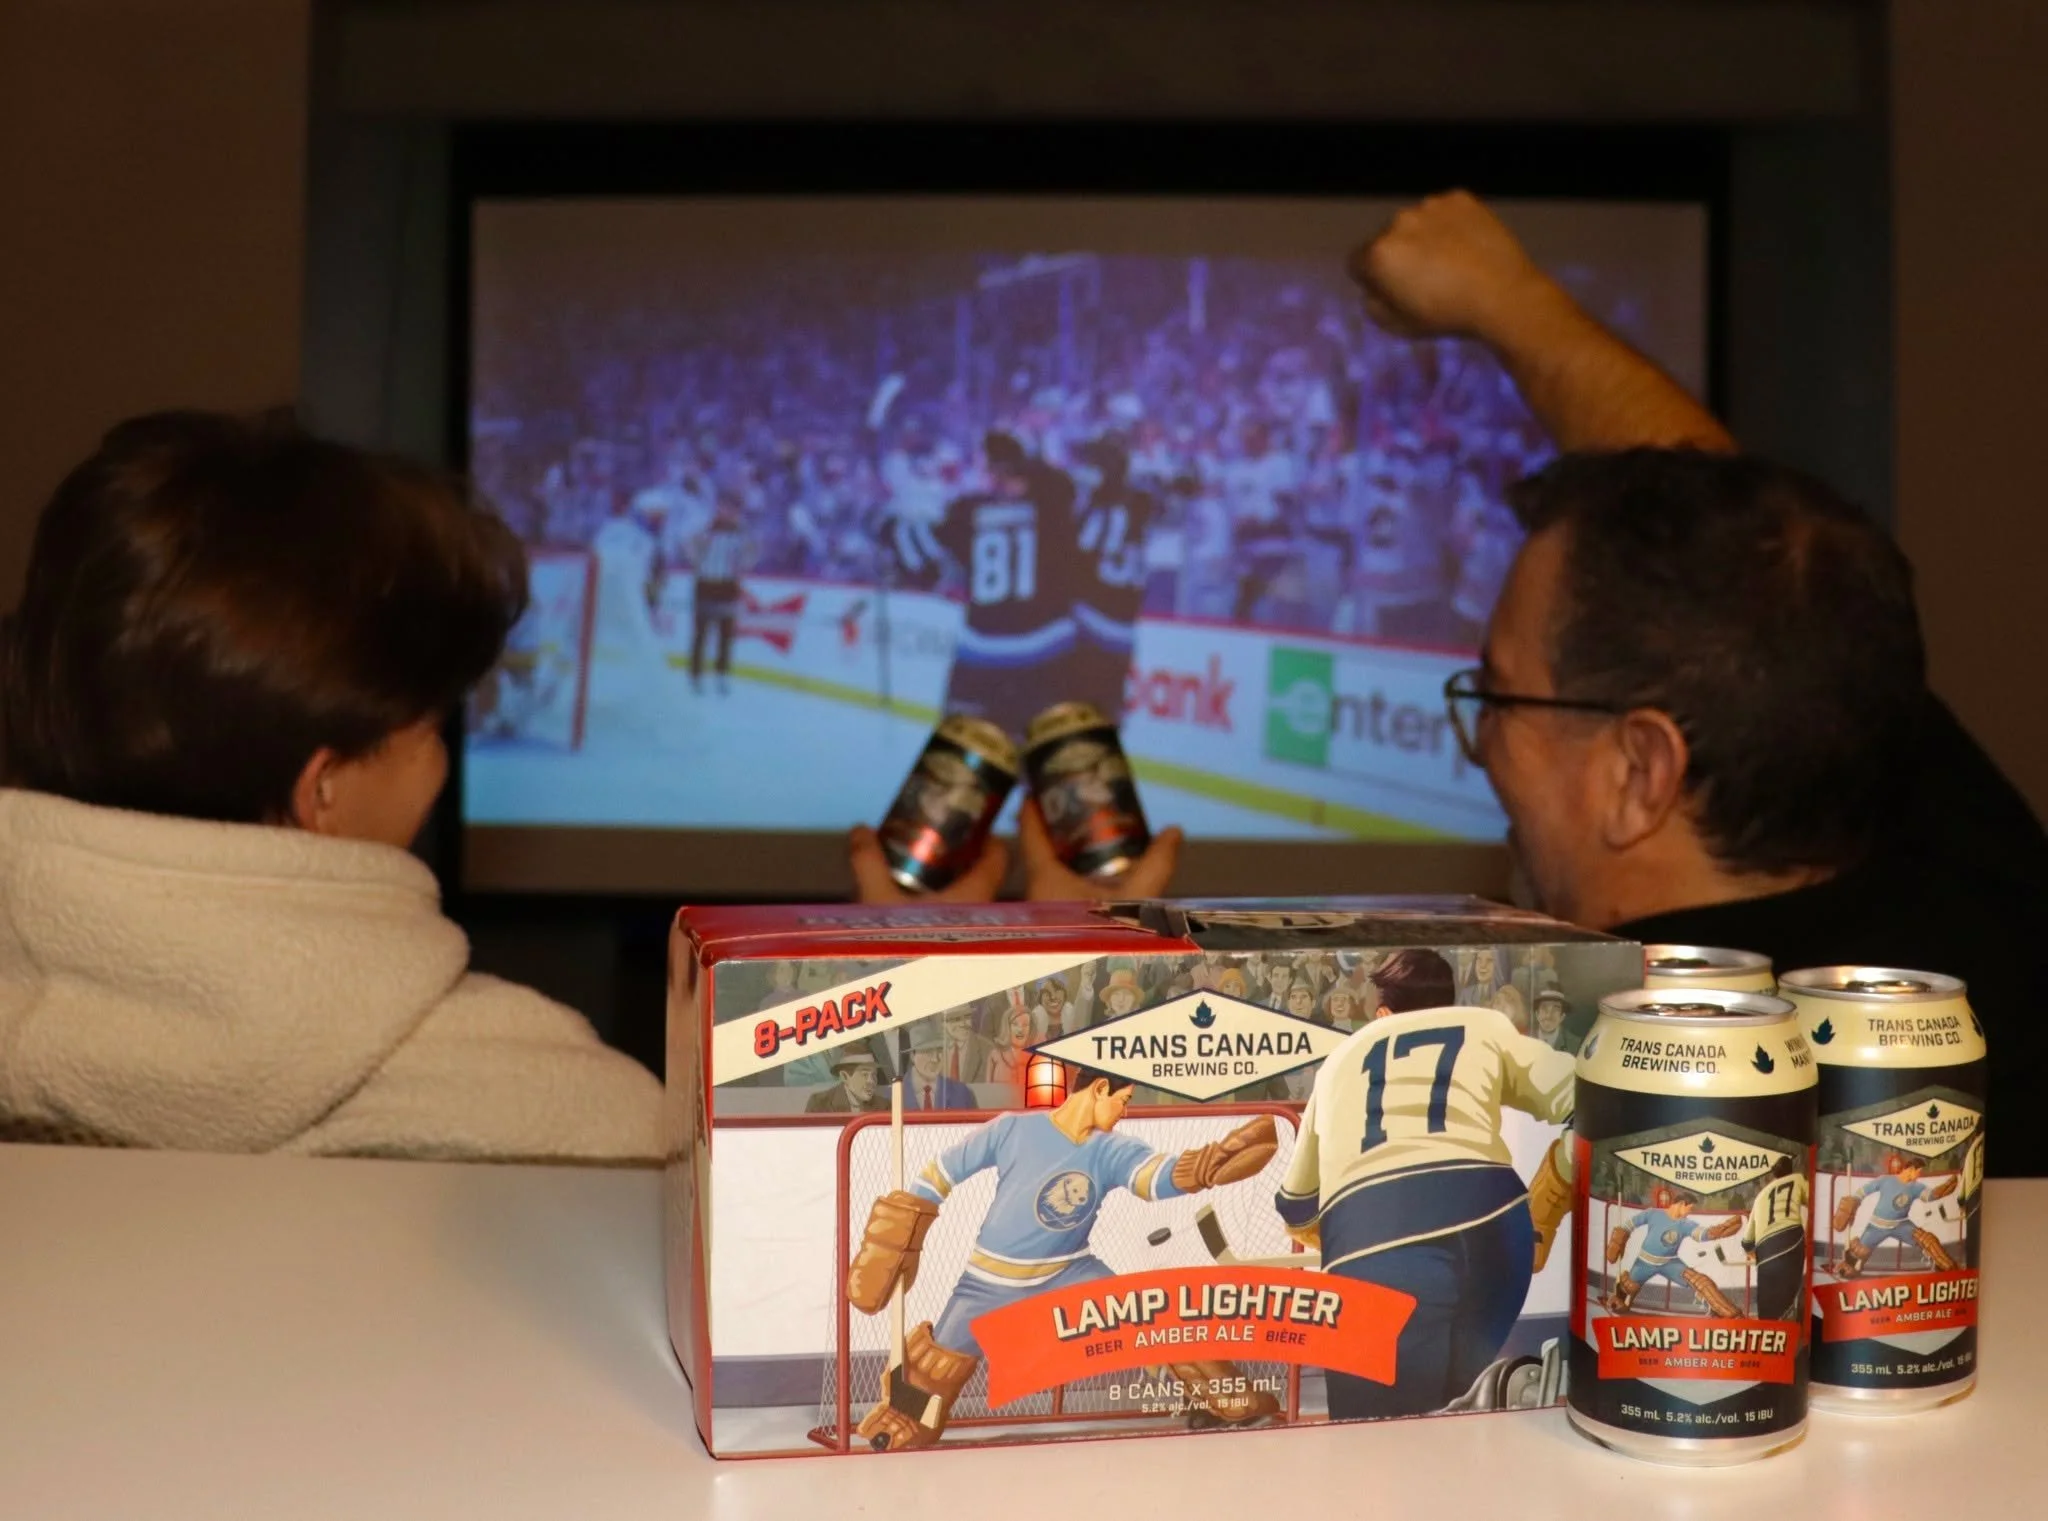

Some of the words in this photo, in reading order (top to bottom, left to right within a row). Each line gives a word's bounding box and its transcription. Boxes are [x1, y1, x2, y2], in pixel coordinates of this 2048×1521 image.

[972, 528, 1037, 605] 81
[754, 981, 892, 1057] 8-PACK
[1868, 1019, 1914, 1033] TRANS
[1917, 1015, 1962, 1031] CANADA
[1091, 1034, 1187, 1060] TRANS
[1197, 1031, 1313, 1057] CANADA
[1620, 1037, 1662, 1056] TRANS
[1665, 1043, 1727, 1059] CANADA
[1879, 1032, 1945, 1048] BREWING
[1947, 1031, 1963, 1045] CO.
[1152, 1062, 1228, 1077] BREWING
[1233, 1060, 1259, 1076] CO.
[1622, 1055, 1690, 1074] BREWING
[1695, 1061, 1720, 1074] CO.
[1360, 1025, 1466, 1154] 17
[1872, 1121, 1925, 1137] TRANS
[1929, 1116, 1975, 1135] CANADA
[1906, 1136, 1945, 1147] BREWING
[1641, 1151, 1697, 1169] TRANS
[1702, 1153, 1769, 1171] CANADA
[1675, 1171, 1721, 1182] BREWING
[1724, 1172, 1741, 1182] CO.
[1767, 1181, 1795, 1226] 17
[1838, 1285, 1912, 1314] LAMP
[1052, 1287, 1169, 1341] LAMP
[1177, 1282, 1343, 1329] LIGHTER
[1895, 1310, 1933, 1323] AMBER
[1935, 1308, 1952, 1320] ALE
[1085, 1339, 1123, 1357] BEER
[1135, 1325, 1208, 1348] AMBER
[1215, 1325, 1256, 1342] ALE
[1610, 1326, 1681, 1351] LAMP
[1688, 1328, 1787, 1354] LIGHTER
[1664, 1356, 1708, 1368] AMBER
[1711, 1358, 1735, 1369] ALE
[1851, 1363, 1873, 1374] 355
[1875, 1365, 1892, 1375] mL
[1897, 1363, 1920, 1375] 5.2%
[1109, 1384, 1121, 1400] 8
[1128, 1381, 1185, 1400] CANS
[1208, 1376, 1246, 1395] 355
[1253, 1375, 1281, 1392] mL
[1142, 1402, 1166, 1413] 5.2%
[1620, 1404, 1641, 1417] 355
[1643, 1410, 1661, 1420] mL
[1666, 1411, 1693, 1423] 5.2%
[1695, 1411, 1740, 1424] alc./vol.
[1745, 1411, 1755, 1422] 15
[1758, 1409, 1774, 1420] IBU
